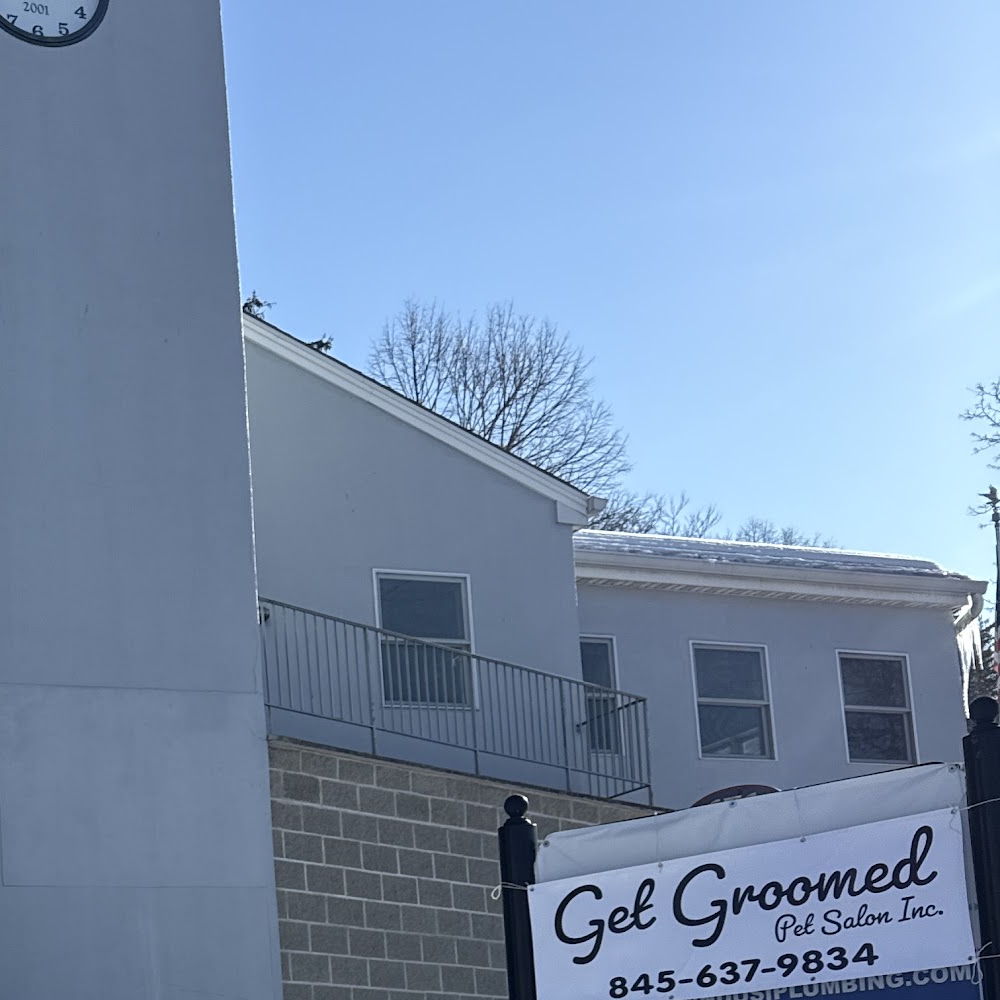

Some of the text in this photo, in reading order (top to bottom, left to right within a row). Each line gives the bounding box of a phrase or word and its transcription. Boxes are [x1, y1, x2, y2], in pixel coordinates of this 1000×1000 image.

[23, 1, 49, 15] 2001
[74, 6, 87, 19] 4
[6, 13, 18, 25] 7
[32, 25, 43, 37] 6
[58, 22, 69, 36] 5
[554, 825, 938, 965] Get Groomed
[774, 895, 944, 943] Pet Salon Inc.
[608, 942, 880, 999] 845-637-9834
